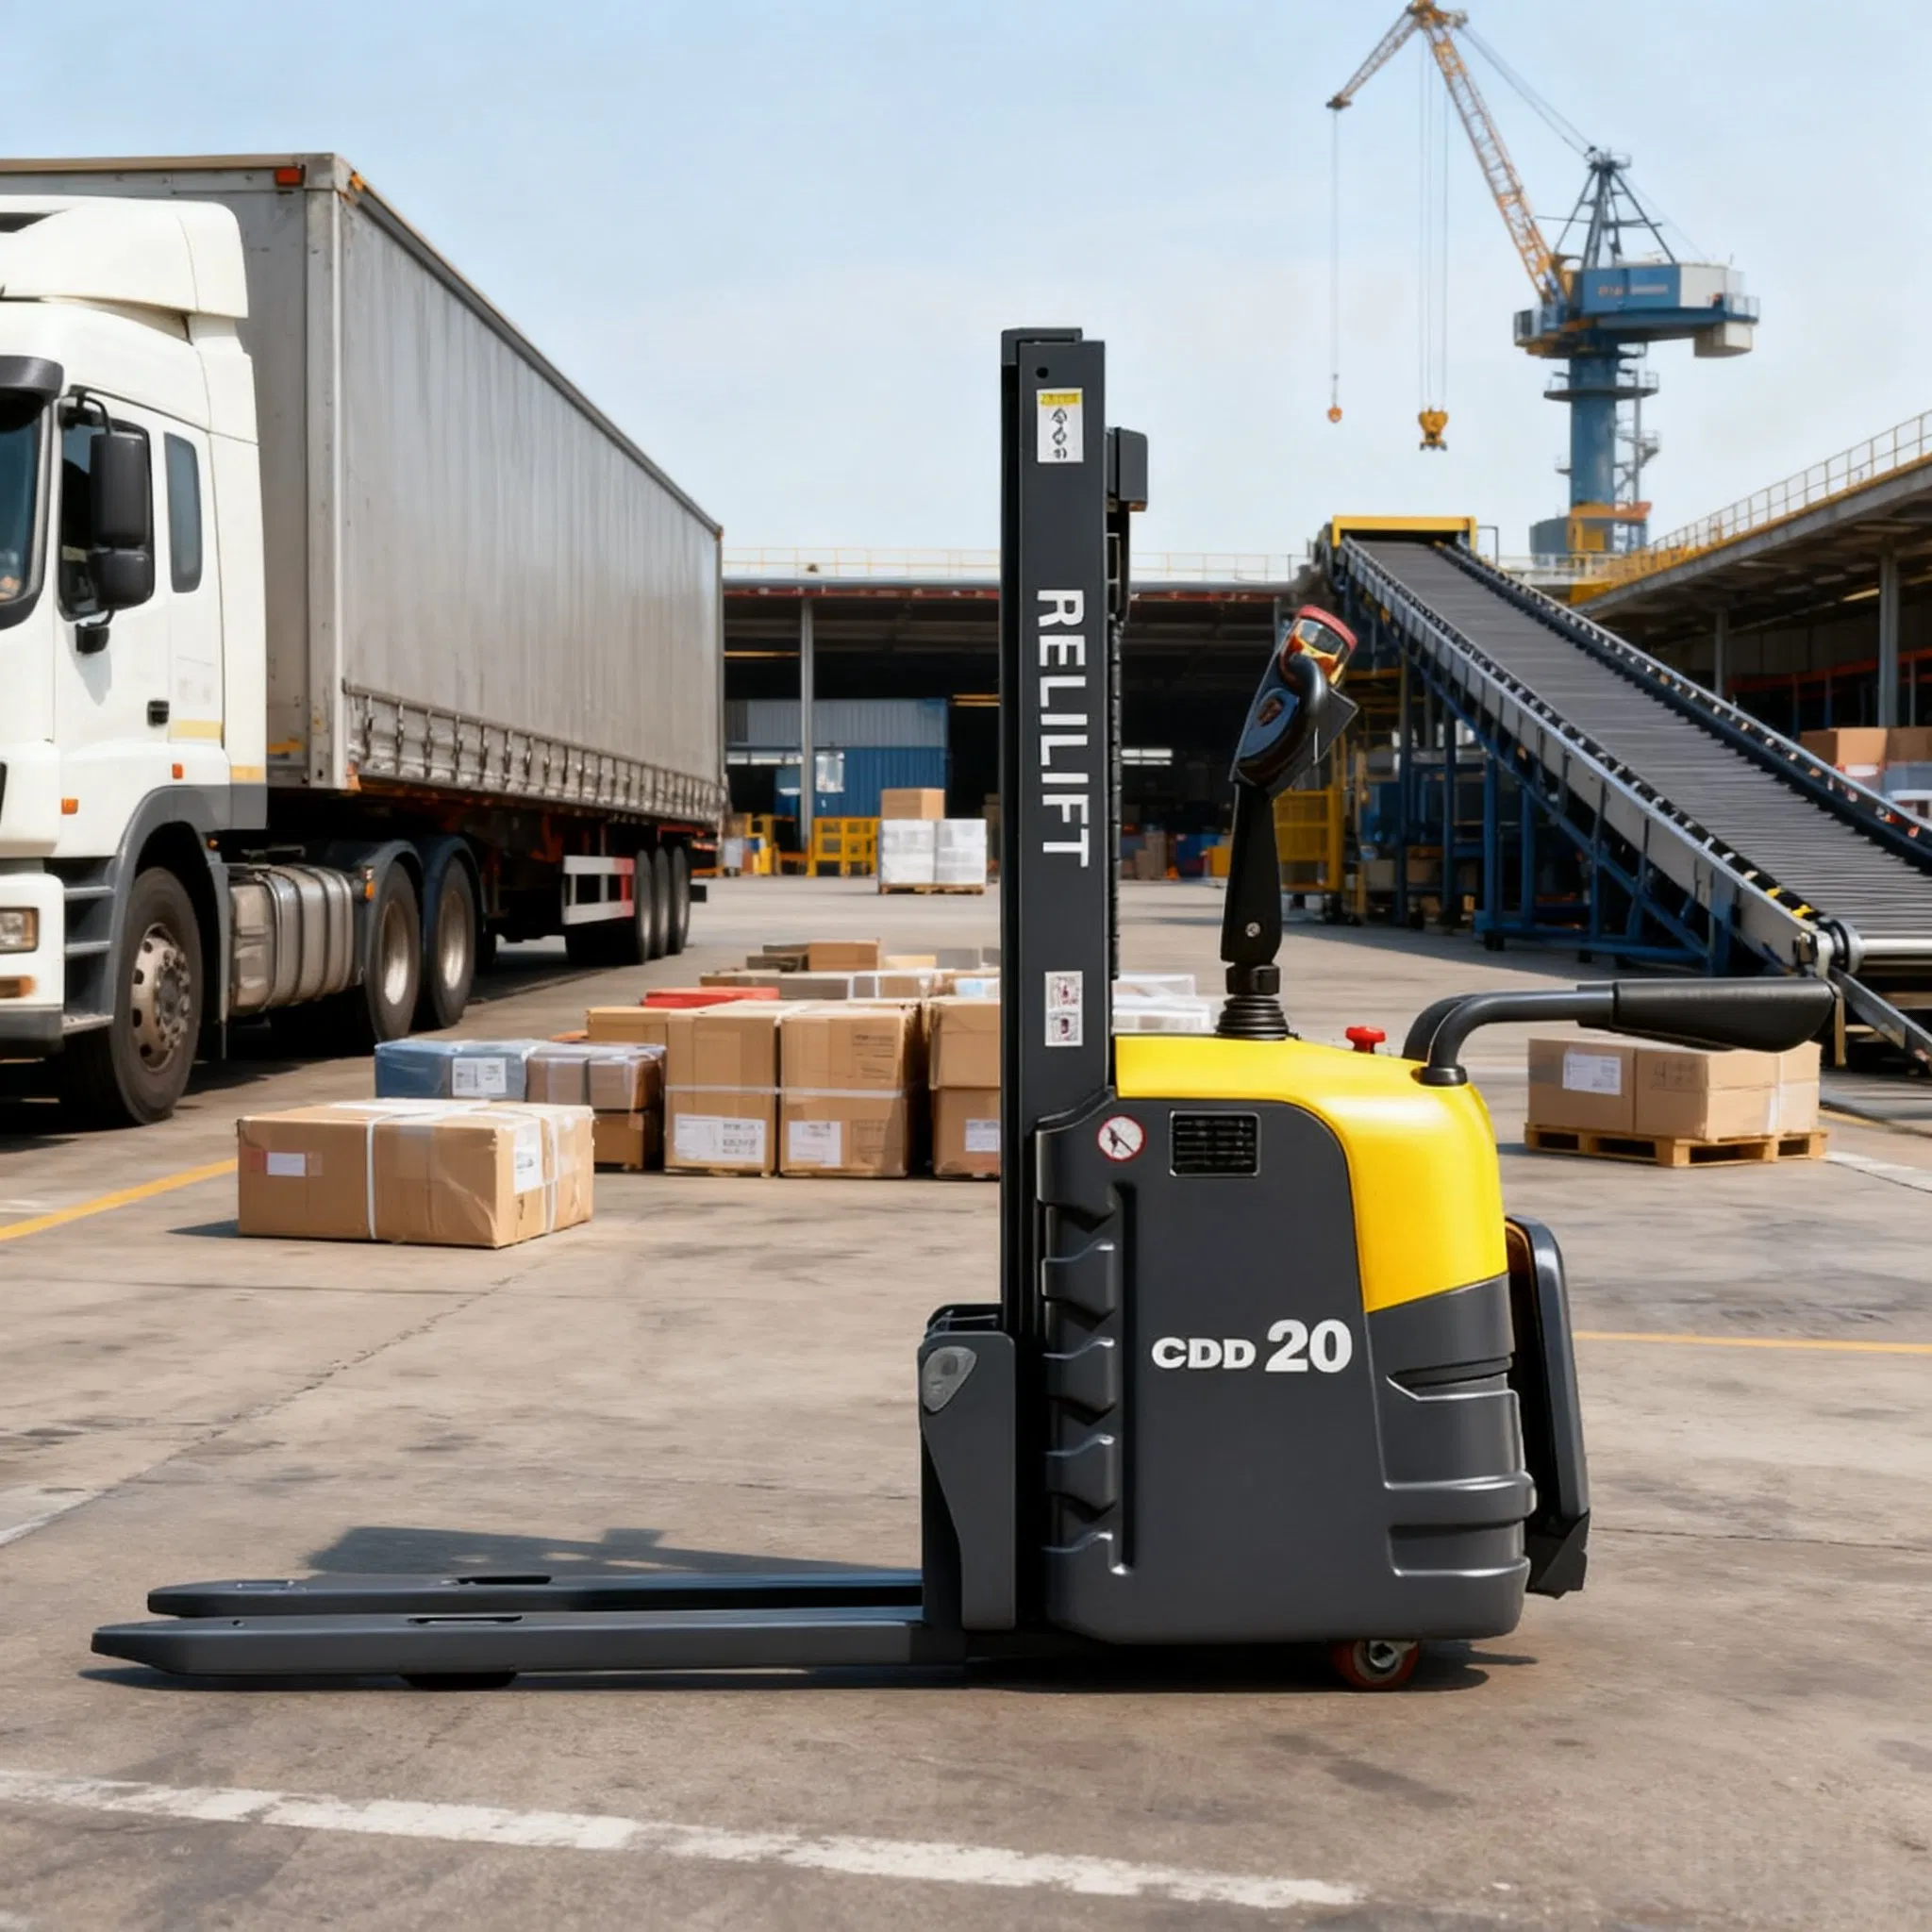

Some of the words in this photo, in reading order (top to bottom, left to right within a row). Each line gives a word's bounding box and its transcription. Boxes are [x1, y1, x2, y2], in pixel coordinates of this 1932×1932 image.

[1037, 590, 1090, 868] RELILIFT
[1151, 1337, 1257, 1370] CDD
[1264, 1319, 1353, 1374] 20
